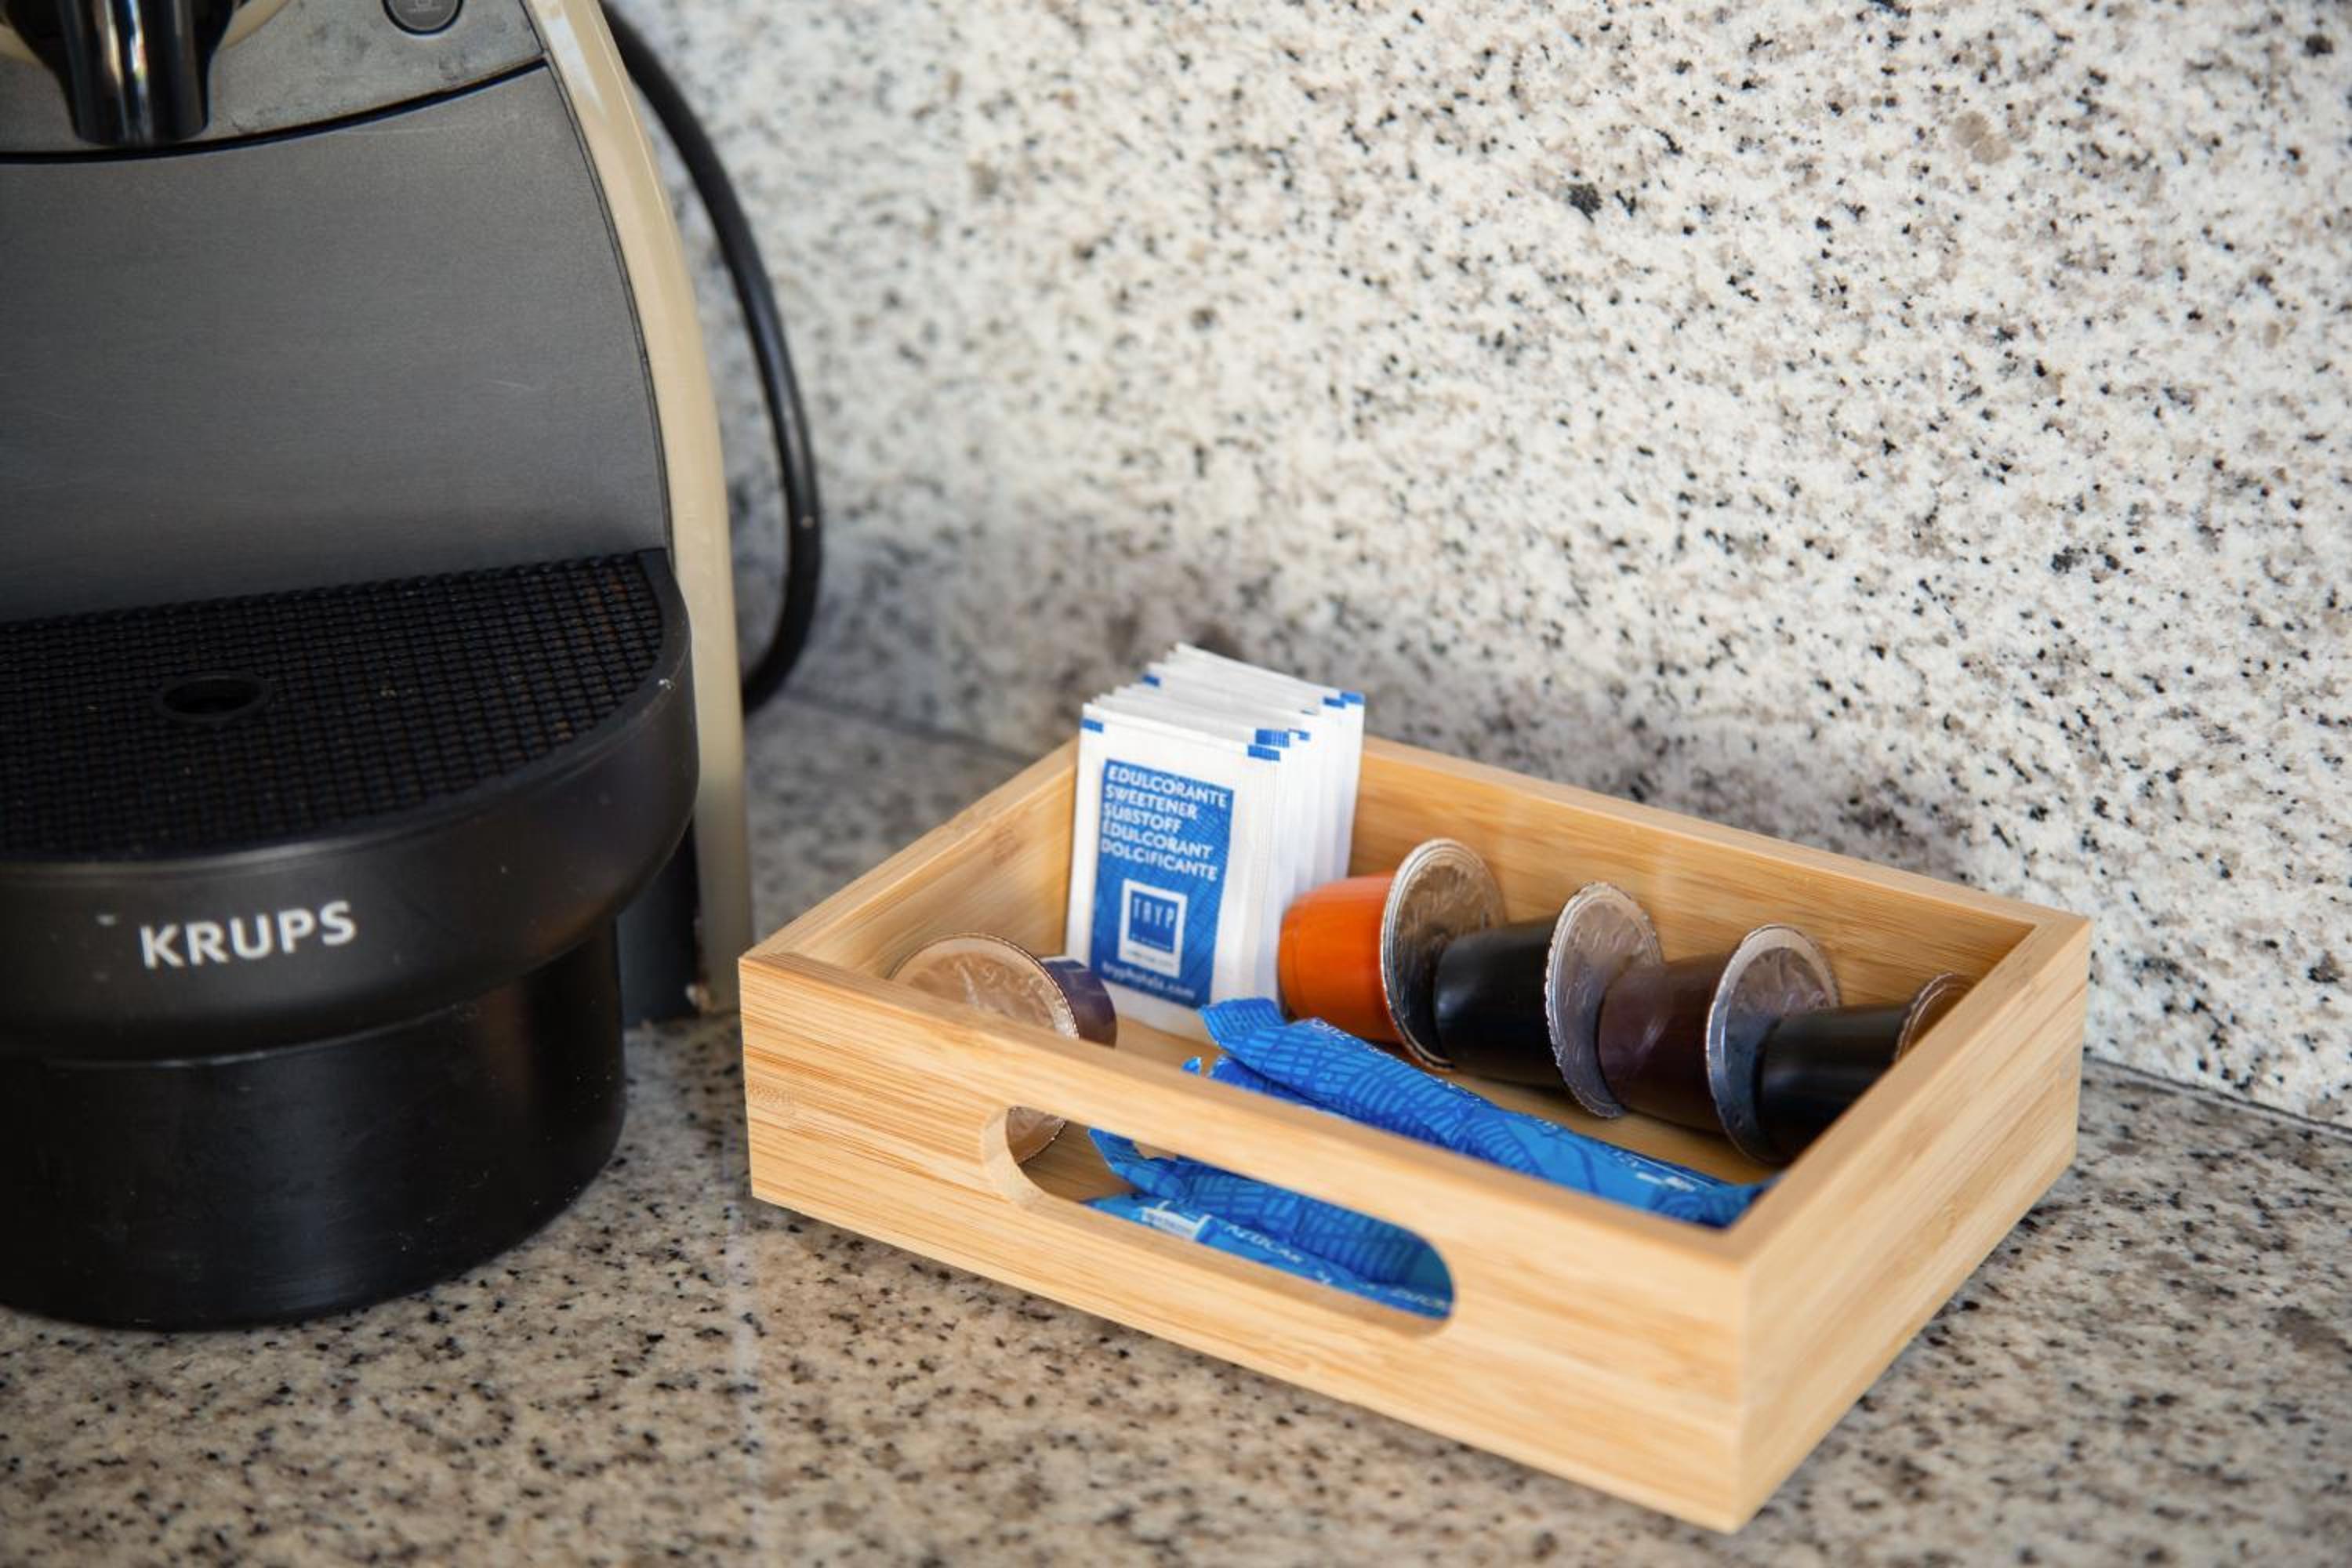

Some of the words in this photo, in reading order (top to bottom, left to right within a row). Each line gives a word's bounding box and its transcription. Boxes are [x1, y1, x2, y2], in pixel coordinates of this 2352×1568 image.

[1105, 783, 1198, 819] SWEETENER
[1107, 765, 1228, 808] EDULCORANTE
[1100, 838, 1218, 880] DOLCIFICANTE
[140, 900, 357, 969] KRUPS
